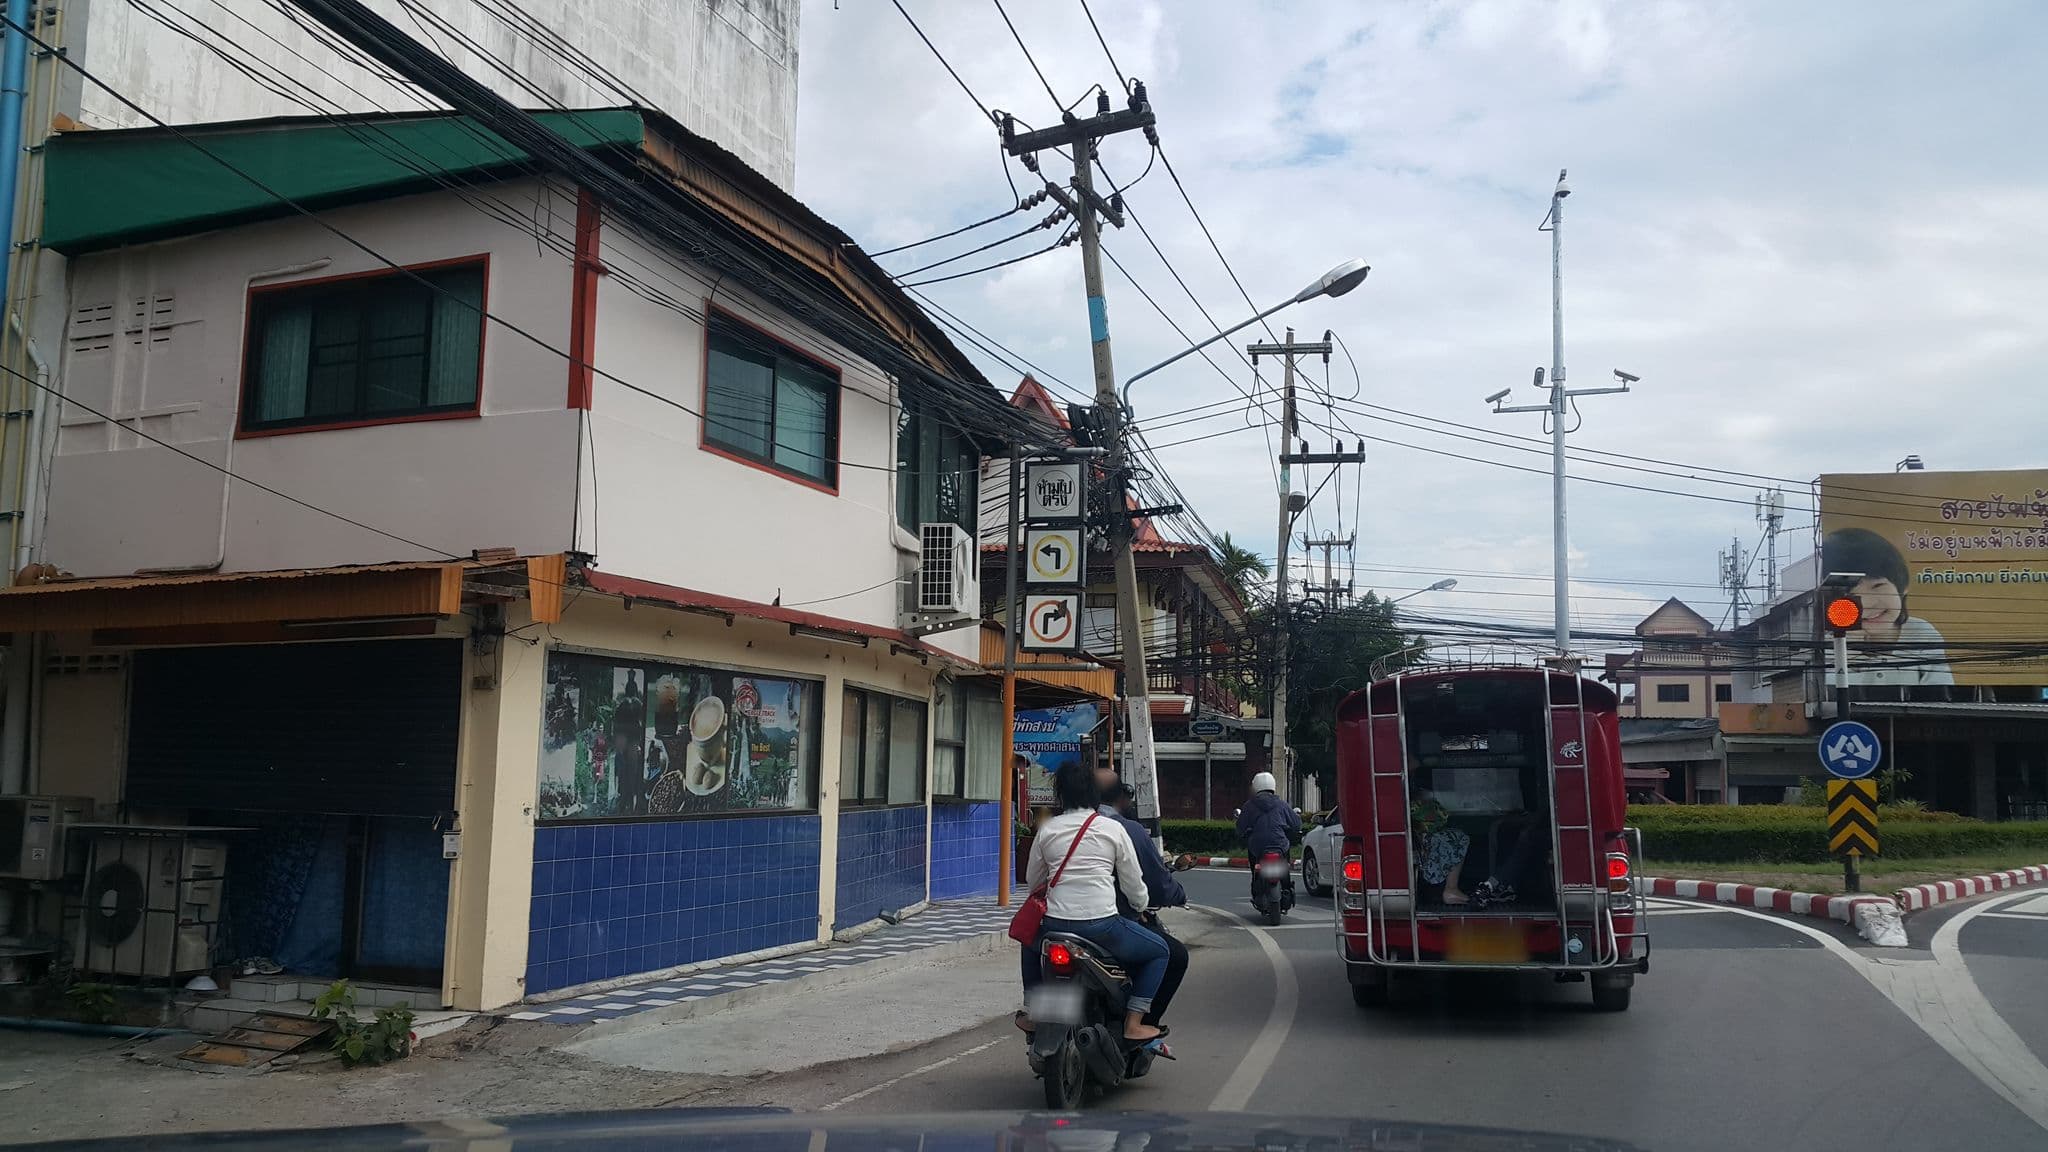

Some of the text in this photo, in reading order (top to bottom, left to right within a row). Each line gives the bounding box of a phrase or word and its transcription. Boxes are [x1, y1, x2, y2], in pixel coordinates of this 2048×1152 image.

[1037, 478, 1072, 495] ห้ามไป
[1042, 494, 1067, 506] ตรง
[1917, 566, 1994, 584] เด็กยิ่งถาม
